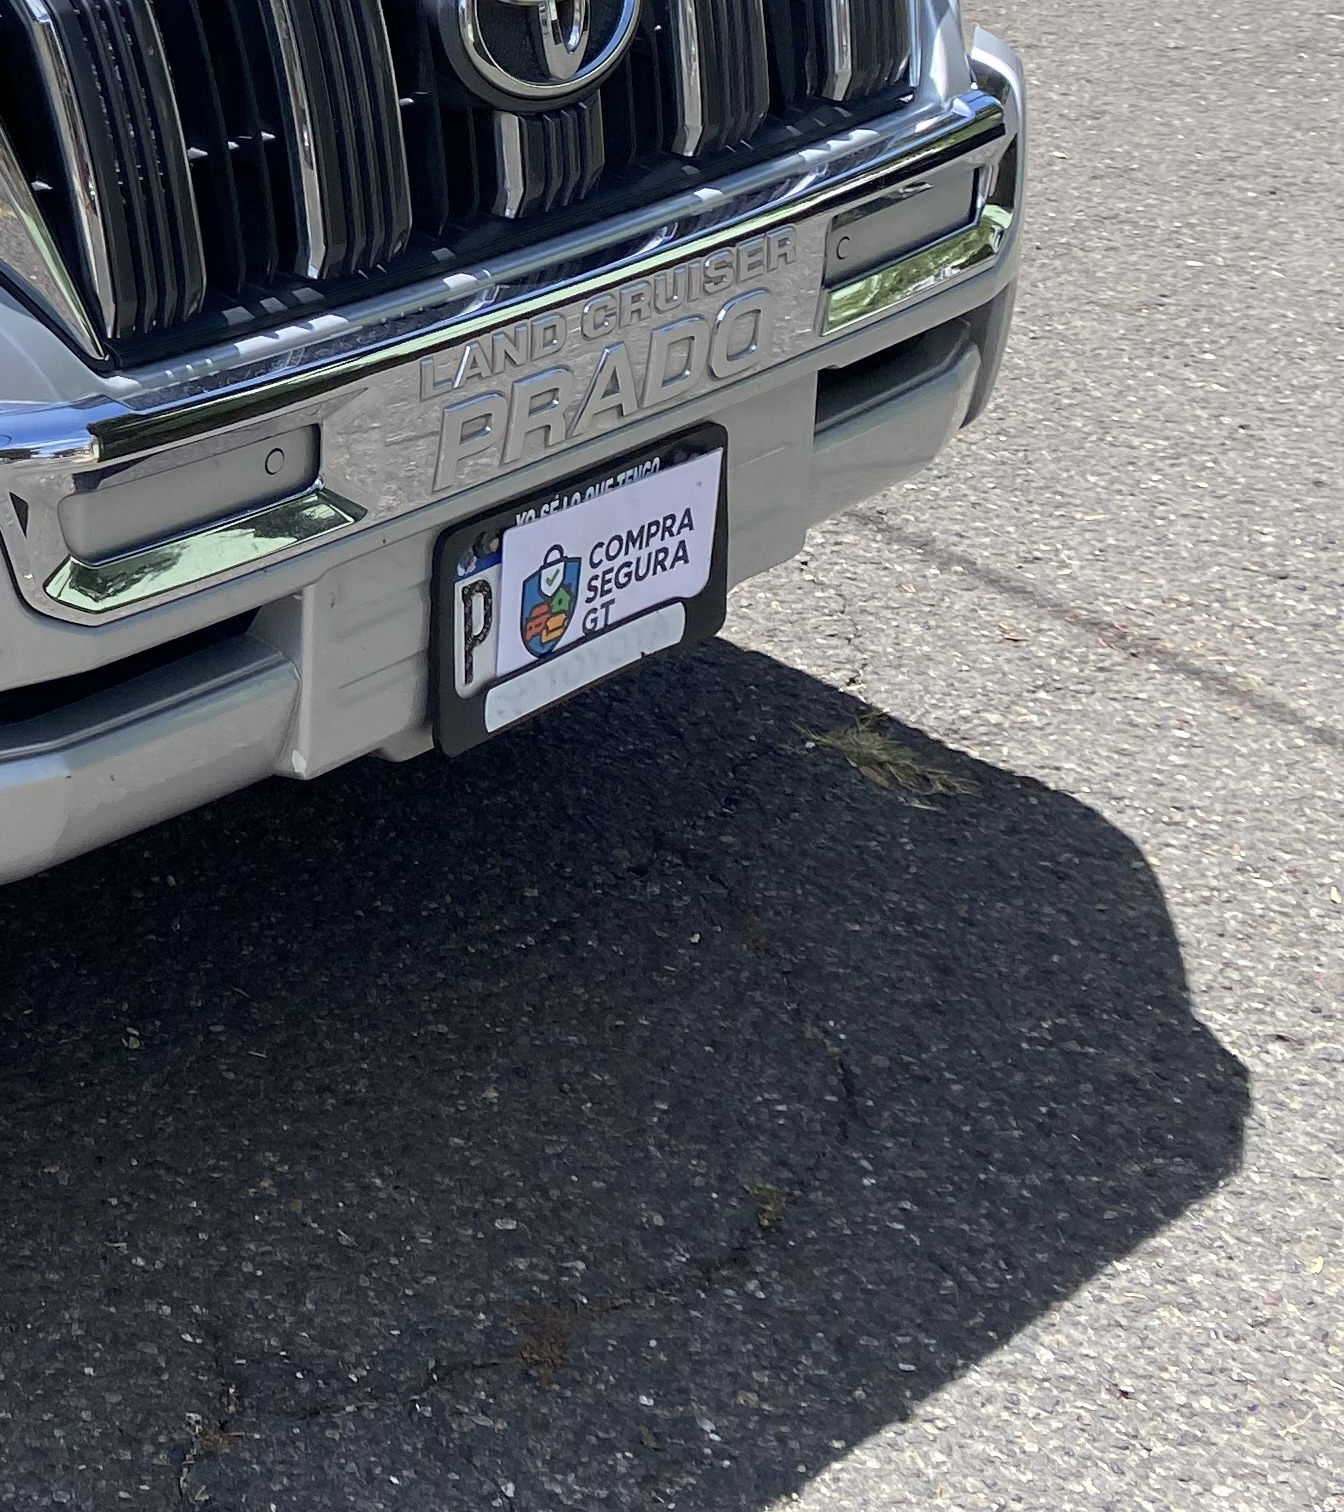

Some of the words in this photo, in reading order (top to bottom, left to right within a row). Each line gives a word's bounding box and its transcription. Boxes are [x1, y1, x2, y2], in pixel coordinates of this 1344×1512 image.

[418, 314, 567, 402] LAND
[581, 225, 798, 341] CRUISER
[433, 288, 771, 493] PRADO
[585, 540, 690, 604] SEGURA
[589, 507, 694, 570] COMPRA
[461, 579, 493, 686] P
[582, 598, 616, 635] GT
